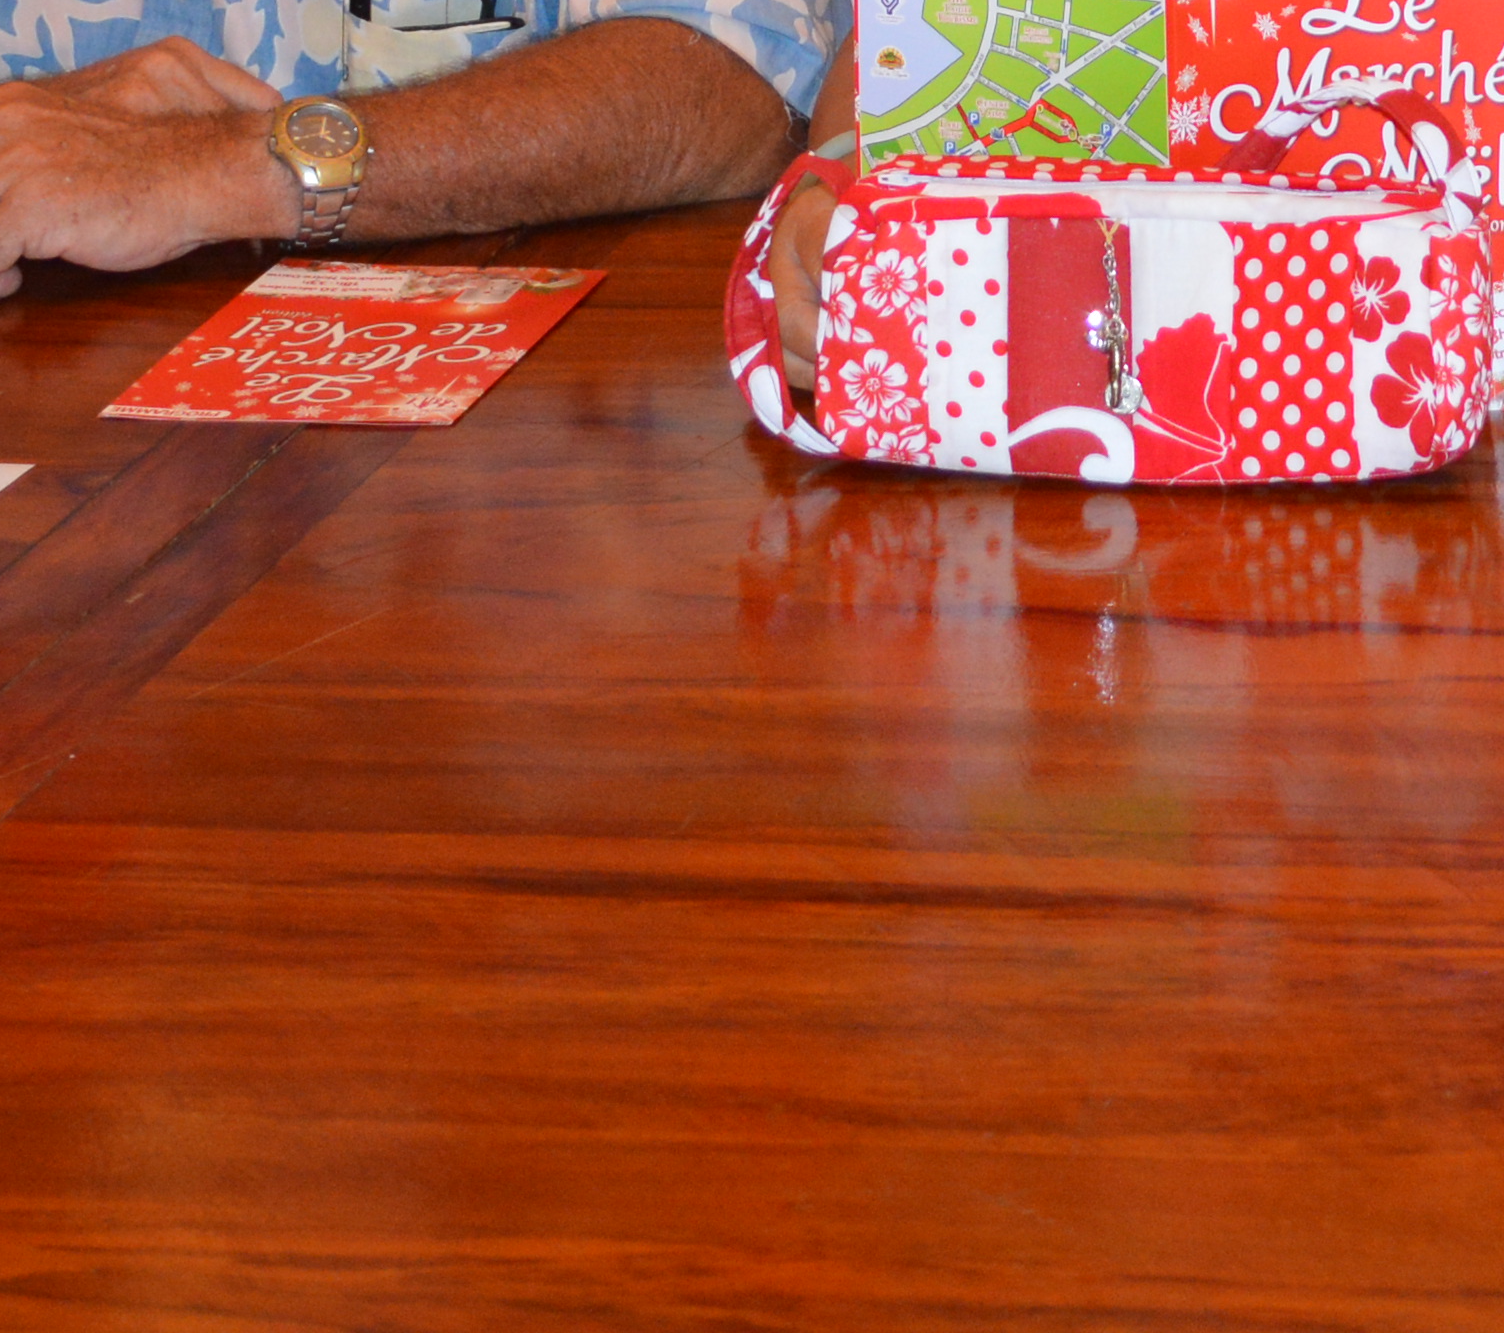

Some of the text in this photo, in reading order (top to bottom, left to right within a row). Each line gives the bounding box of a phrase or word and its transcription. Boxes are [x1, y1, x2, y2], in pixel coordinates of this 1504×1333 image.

[229, 315, 508, 349] de Noël
[192, 343, 491, 373] Marché
[245, 371, 376, 406] Le
[107, 404, 222, 418] PROGRAMME
